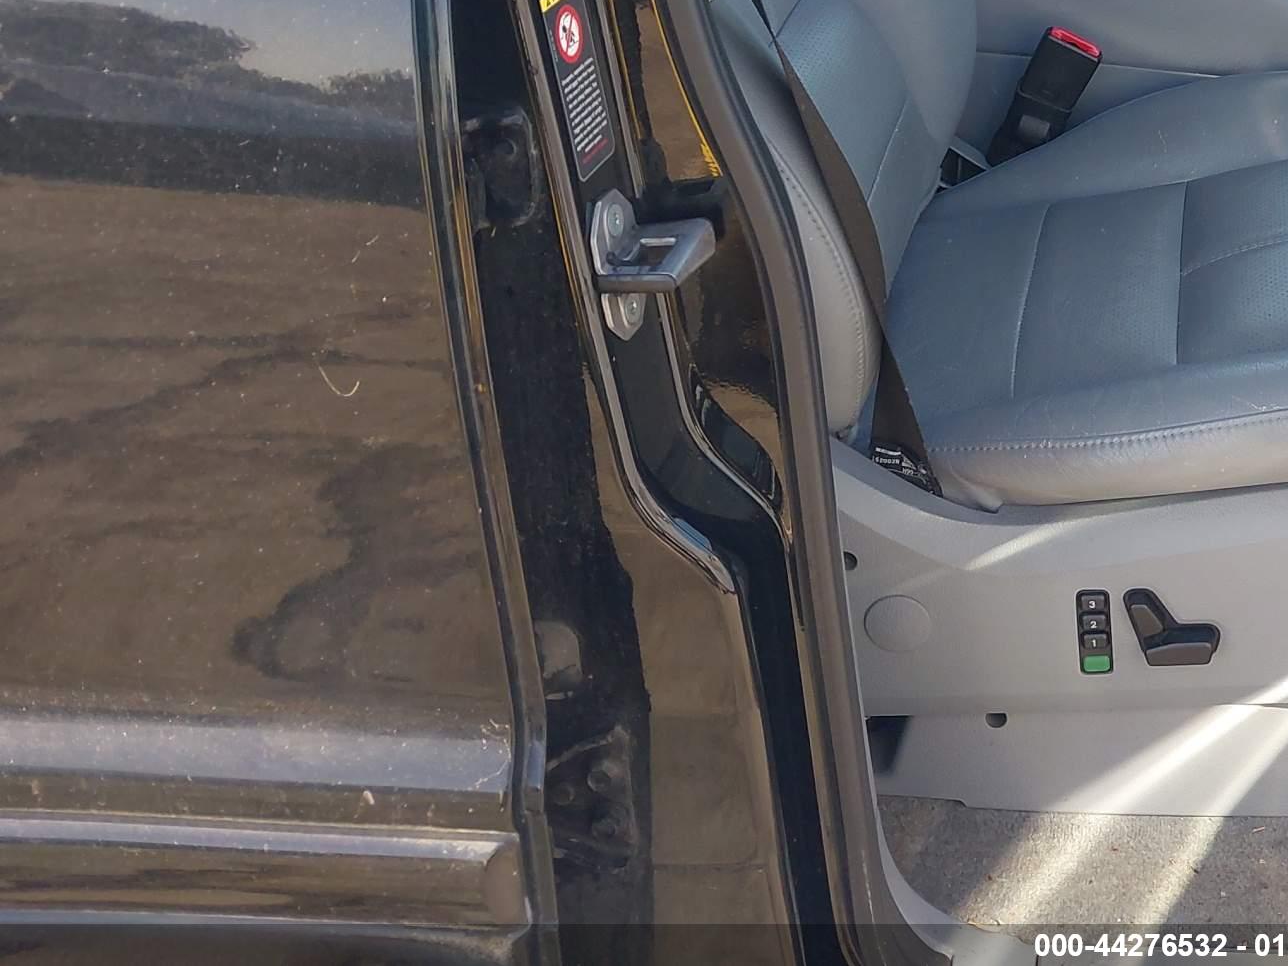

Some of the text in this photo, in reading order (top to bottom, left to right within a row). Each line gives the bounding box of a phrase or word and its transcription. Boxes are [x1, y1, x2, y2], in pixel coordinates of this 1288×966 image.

[1088, 600, 1096, 609] 3
[1090, 621, 1097, 629] 2
[1092, 639, 1097, 647] 1
